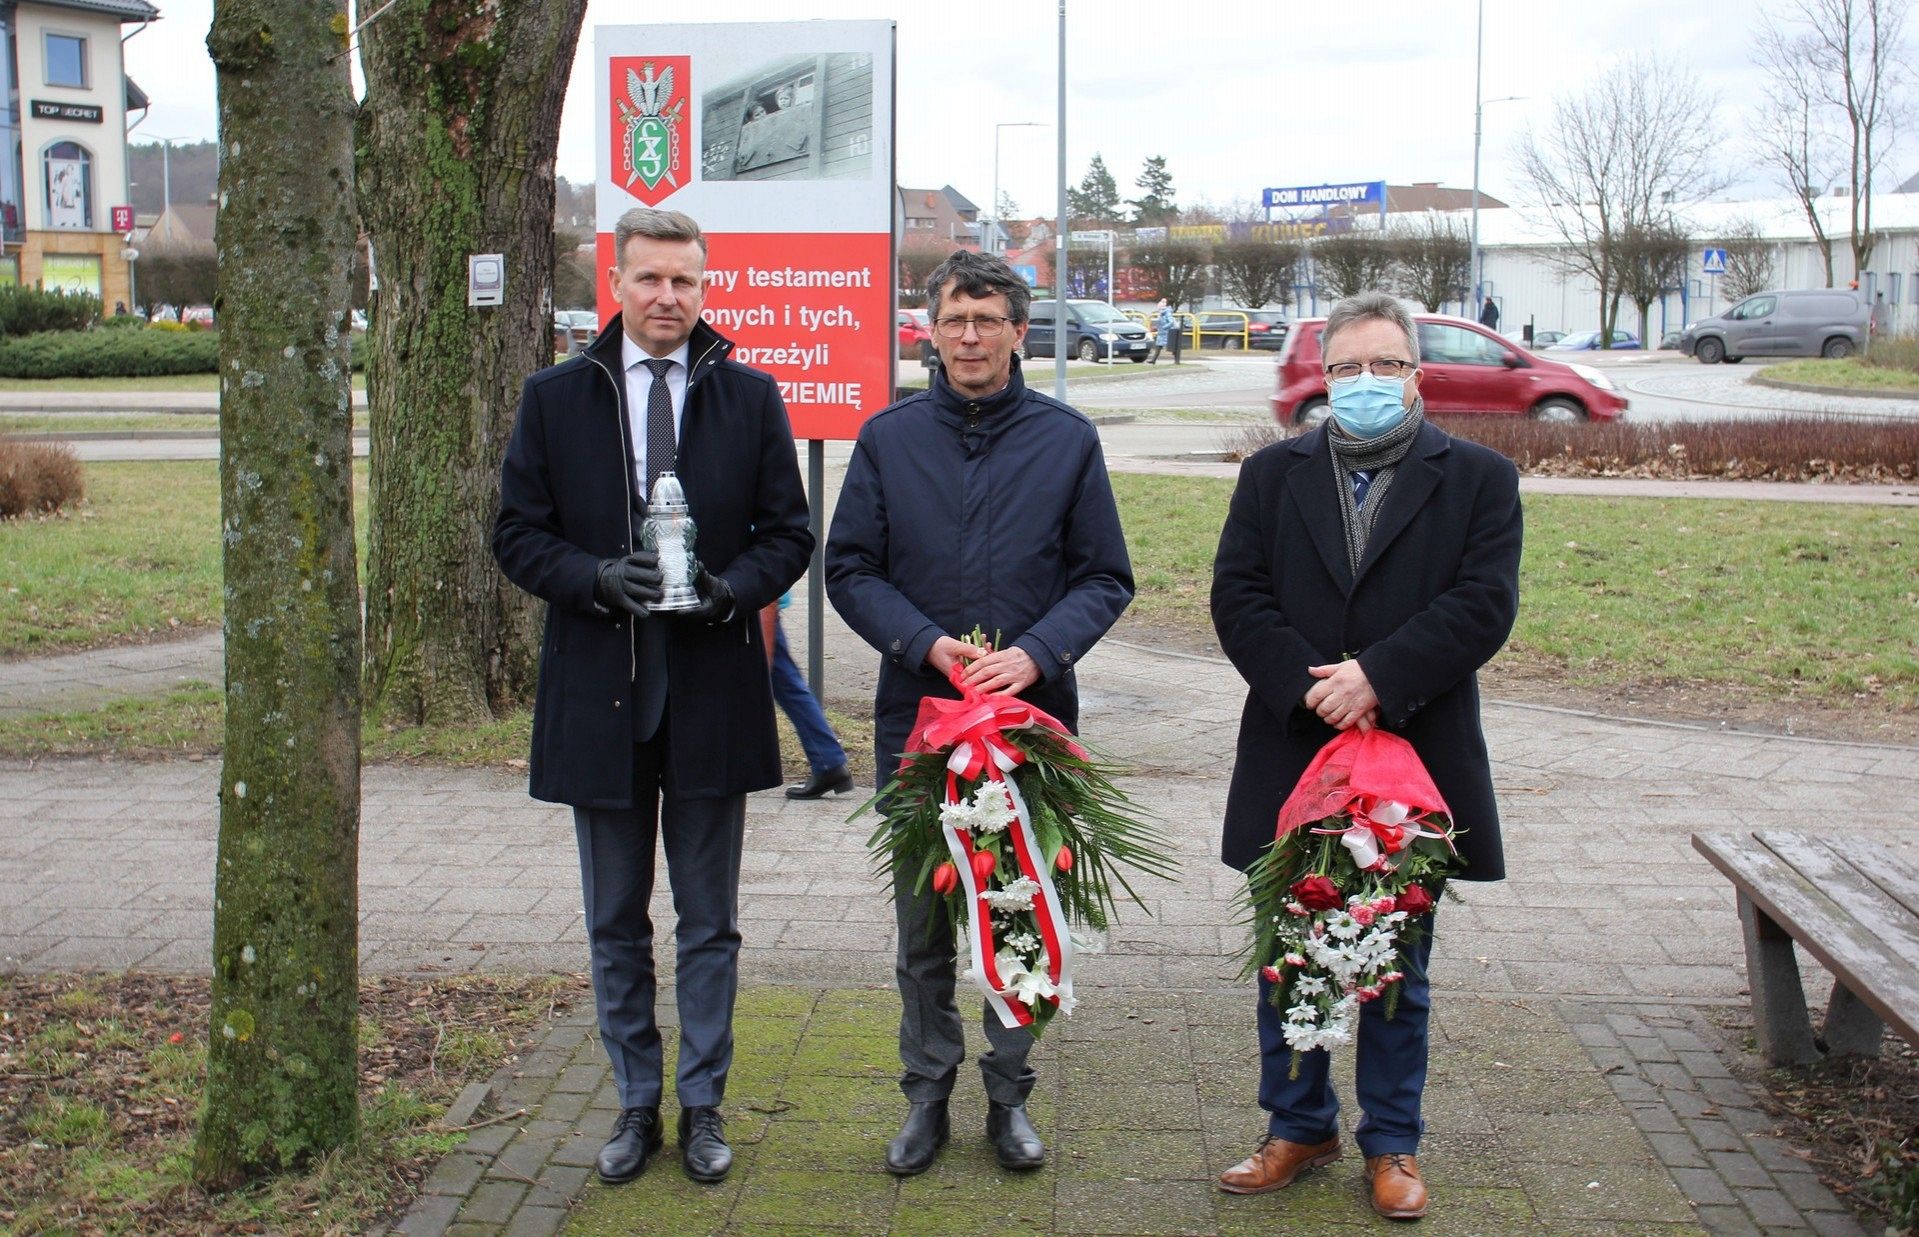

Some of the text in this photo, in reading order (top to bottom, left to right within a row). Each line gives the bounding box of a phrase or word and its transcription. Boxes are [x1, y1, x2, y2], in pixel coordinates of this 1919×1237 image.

[38, 104, 60, 115] TOP
[1272, 183, 1368, 204] DOM HANDLOWY
[702, 267, 871, 293] my testament
[700, 304, 860, 332] onych i tych,
[735, 343, 829, 371] przeżyli
[777, 382, 861, 410] ZIEMIĘ
